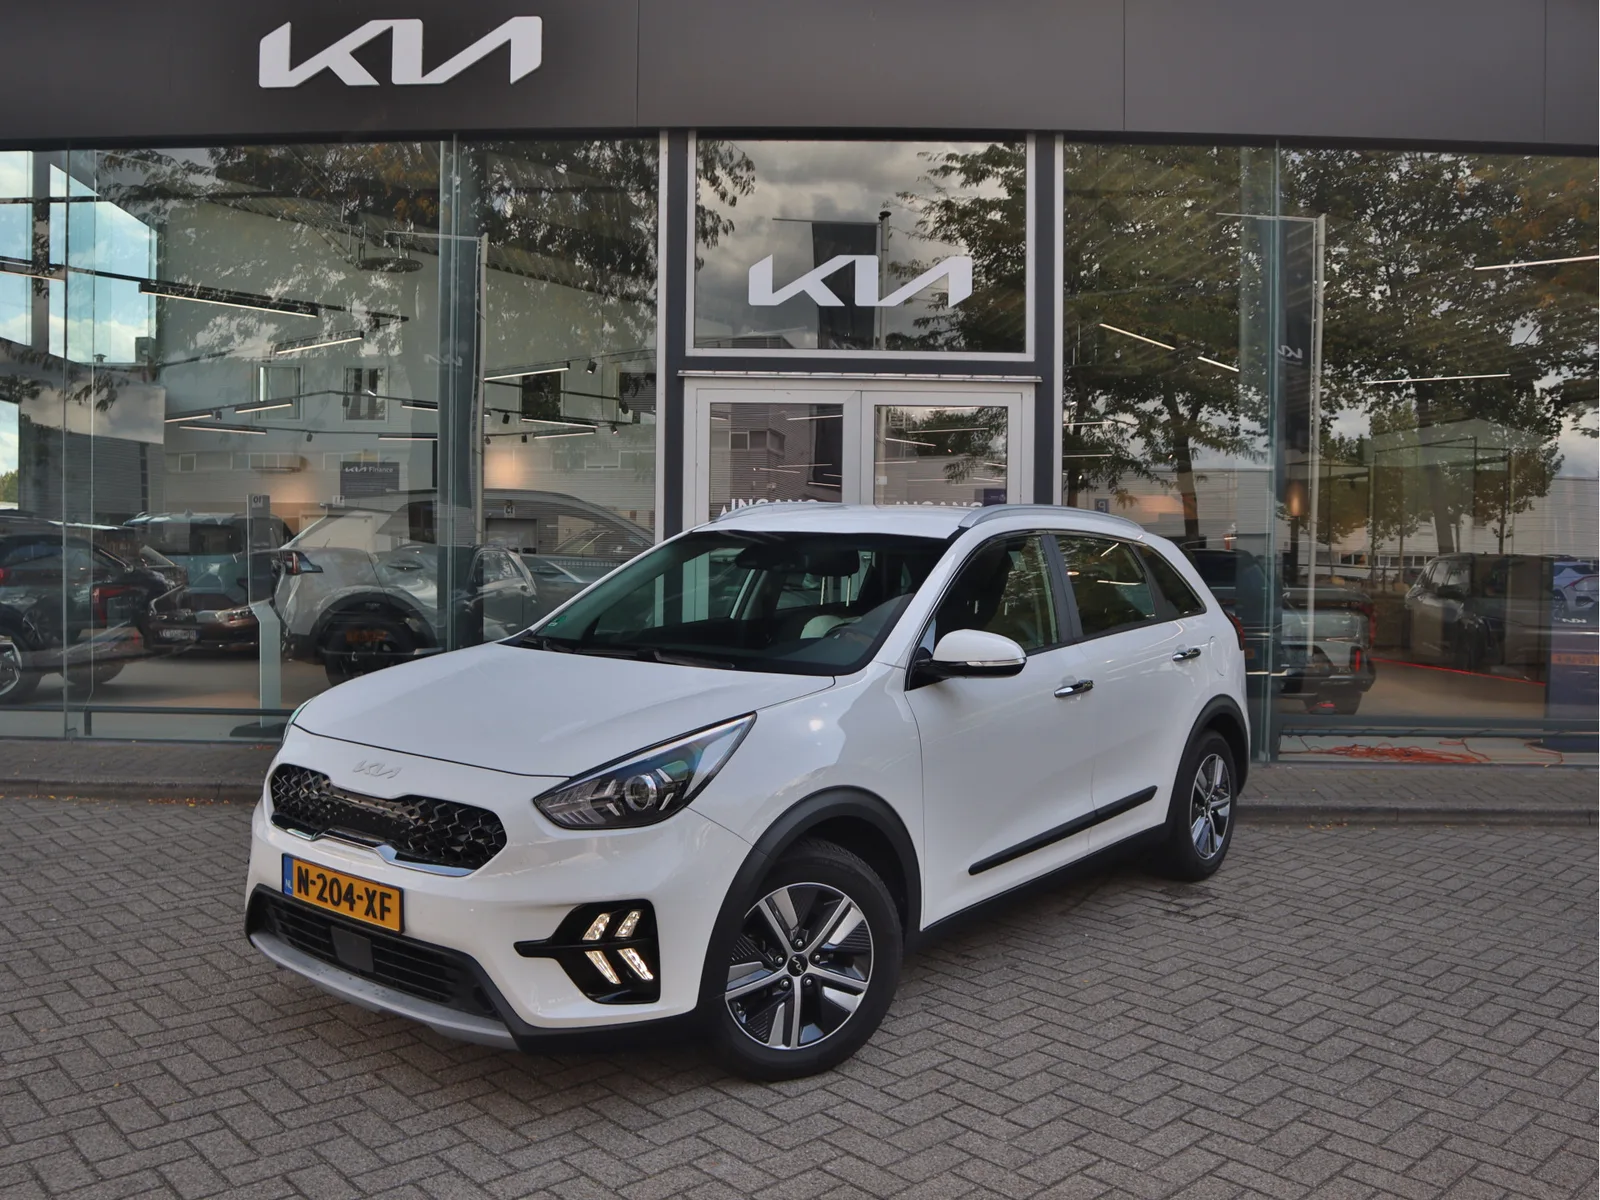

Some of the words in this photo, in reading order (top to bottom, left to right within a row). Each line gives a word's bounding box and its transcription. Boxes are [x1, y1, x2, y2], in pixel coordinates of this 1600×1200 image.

[259, 16, 542, 88] KIA
[748, 254, 973, 308] KIA
[353, 760, 403, 779] KIA
[297, 866, 392, 922] N-204-XF
